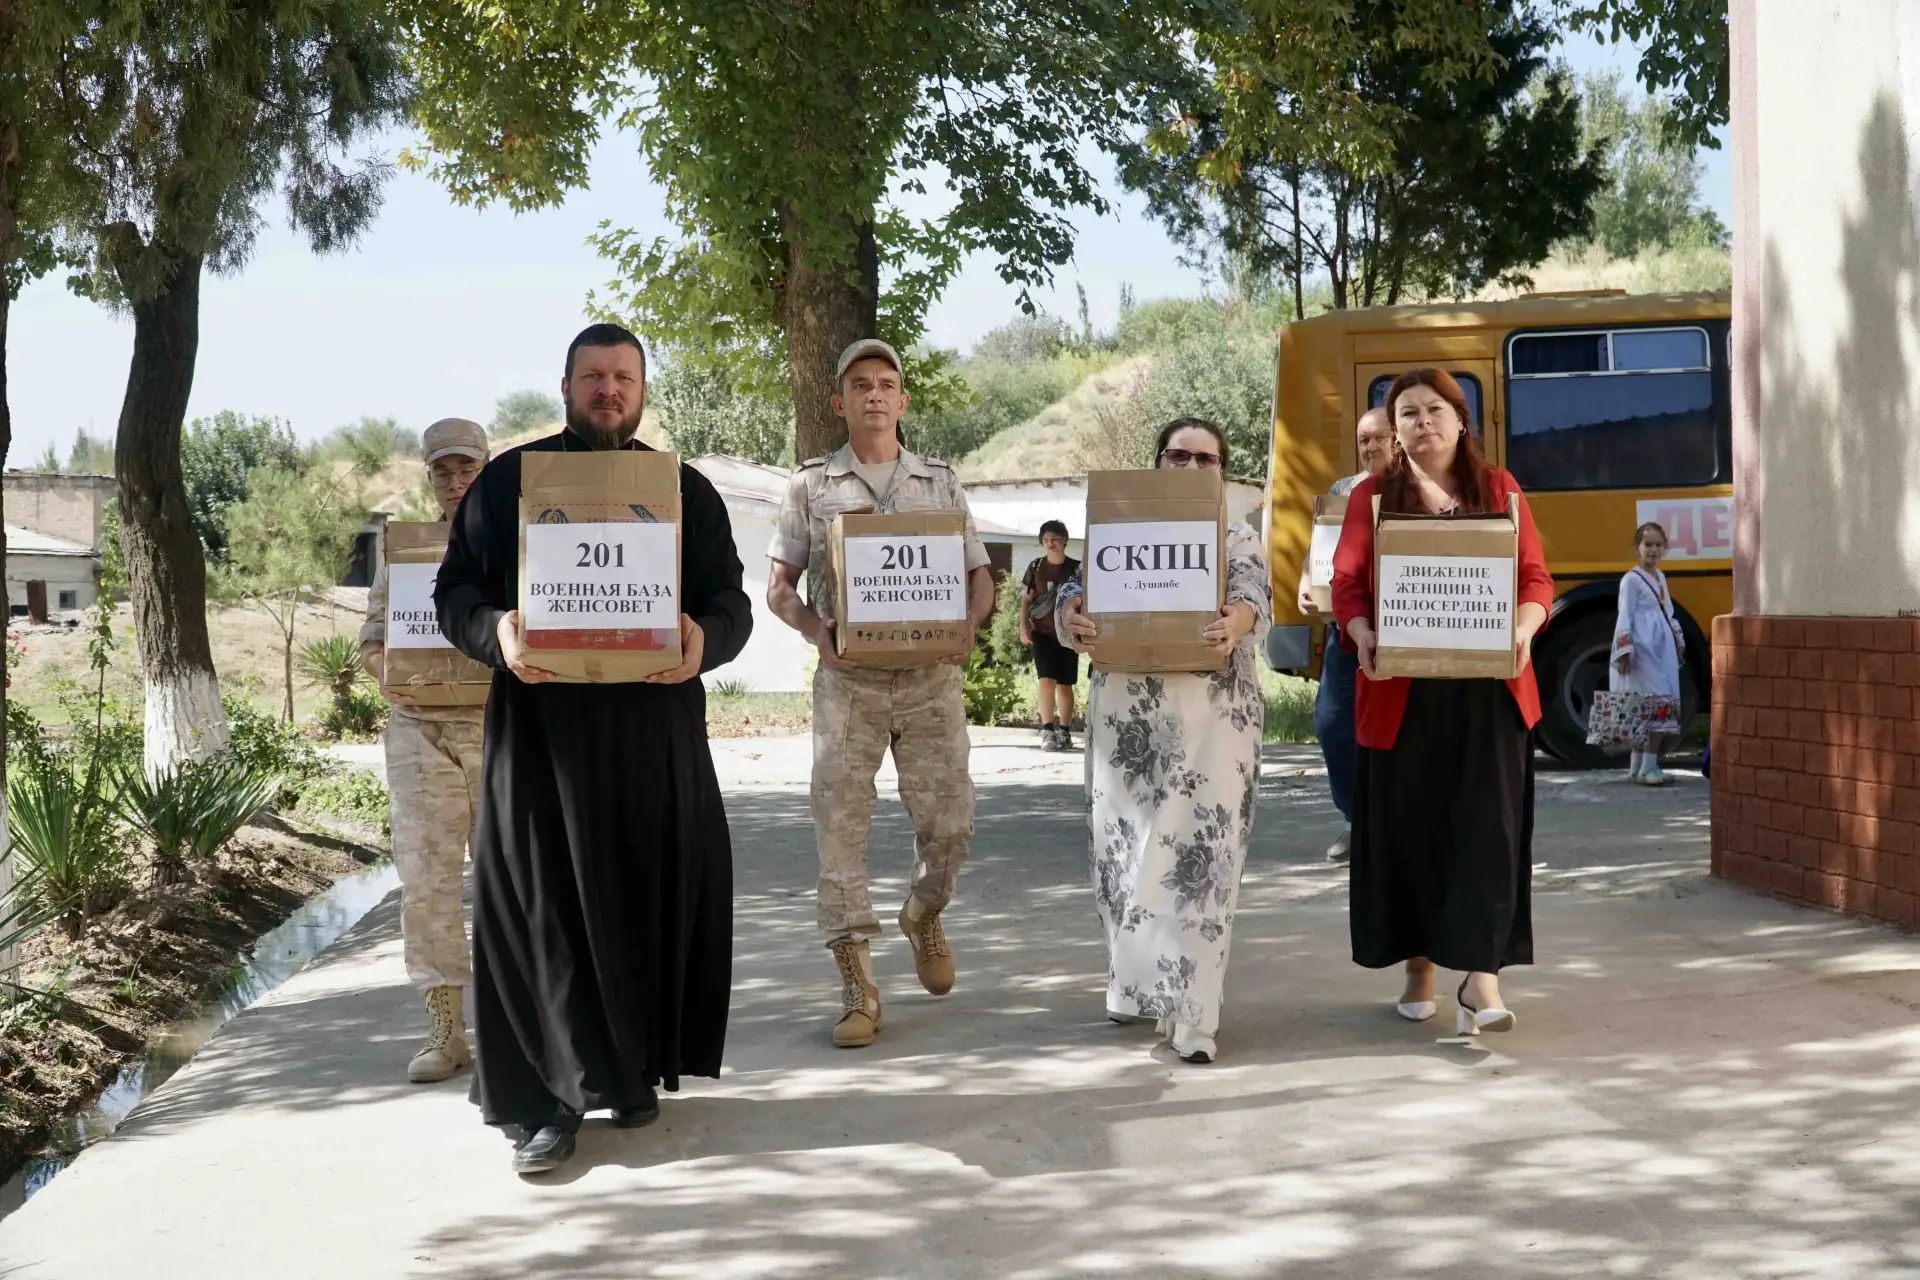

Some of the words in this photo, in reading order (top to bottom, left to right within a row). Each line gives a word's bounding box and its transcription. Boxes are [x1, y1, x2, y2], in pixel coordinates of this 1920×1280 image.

[575, 542, 626, 568] 201
[880, 544, 929, 570] 201
[1095, 543, 1210, 576] СКПЦ
[1399, 565, 1490, 579] ДВИЖЕНИЕ
[853, 575, 922, 588] ВОЕННАЯ
[925, 574, 960, 586] БАЗА
[1134, 579, 1181, 591] Душанбе
[530, 583, 621, 597] ВОЕННАЯ
[626, 583, 672, 598] БАЗА
[860, 588, 954, 603] ЖЕНСОВЕТ
[1395, 582, 1472, 597] ЖЕНЩИН
[1476, 583, 1495, 596] ЗА
[547, 599, 655, 613] ЖЕНСОВЕТ
[1381, 600, 1493, 615] МИЛОСЕРДИЕ
[1497, 601, 1508, 613] И
[1382, 615, 1506, 631] ПРОСВЕЩЕНИЕ
